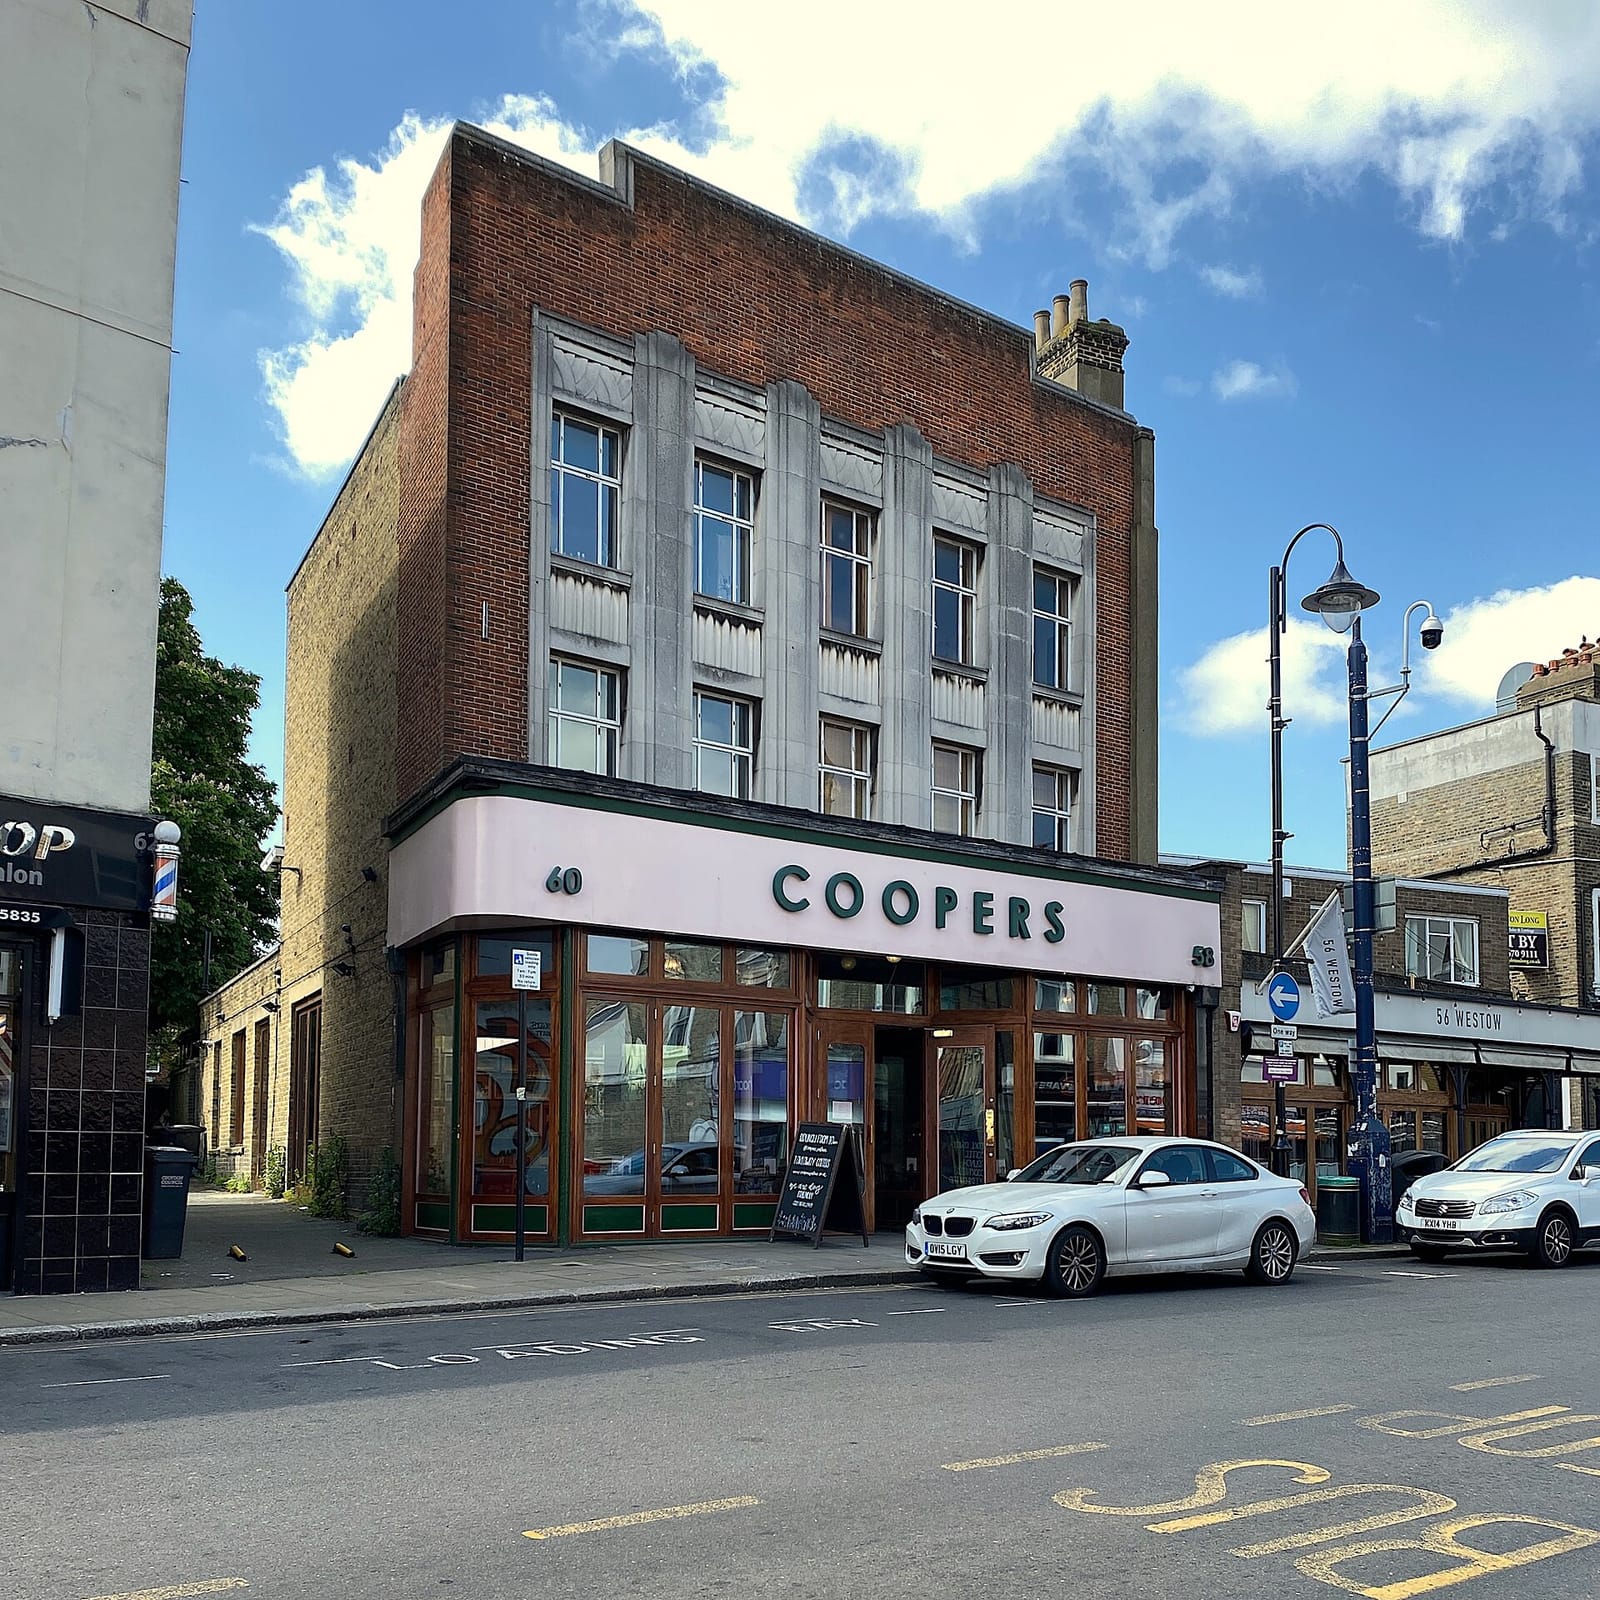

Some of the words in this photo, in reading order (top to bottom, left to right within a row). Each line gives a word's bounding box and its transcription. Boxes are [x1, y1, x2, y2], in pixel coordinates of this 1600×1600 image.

[545, 866, 583, 895] 60
[771, 863, 1065, 944] COOPERS
[0, 909, 40, 923] 5835
[1322, 939, 1335, 953] 56
[1518, 935, 1538, 949] BY
[1191, 945, 1215, 967] 58
[1520, 950, 1538, 959] 9111
[1325, 959, 1344, 1008] WESTOW
[1436, 1008, 1450, 1026] 56
[1455, 1009, 1501, 1031] WESTOW
[929, 1244, 945, 1254] OV15
[946, 1245, 962, 1256] LGY
[370, 1334, 706, 1369] LOADING
[767, 1318, 880, 1332] BAY
[1051, 1458, 1600, 1600] BUS
